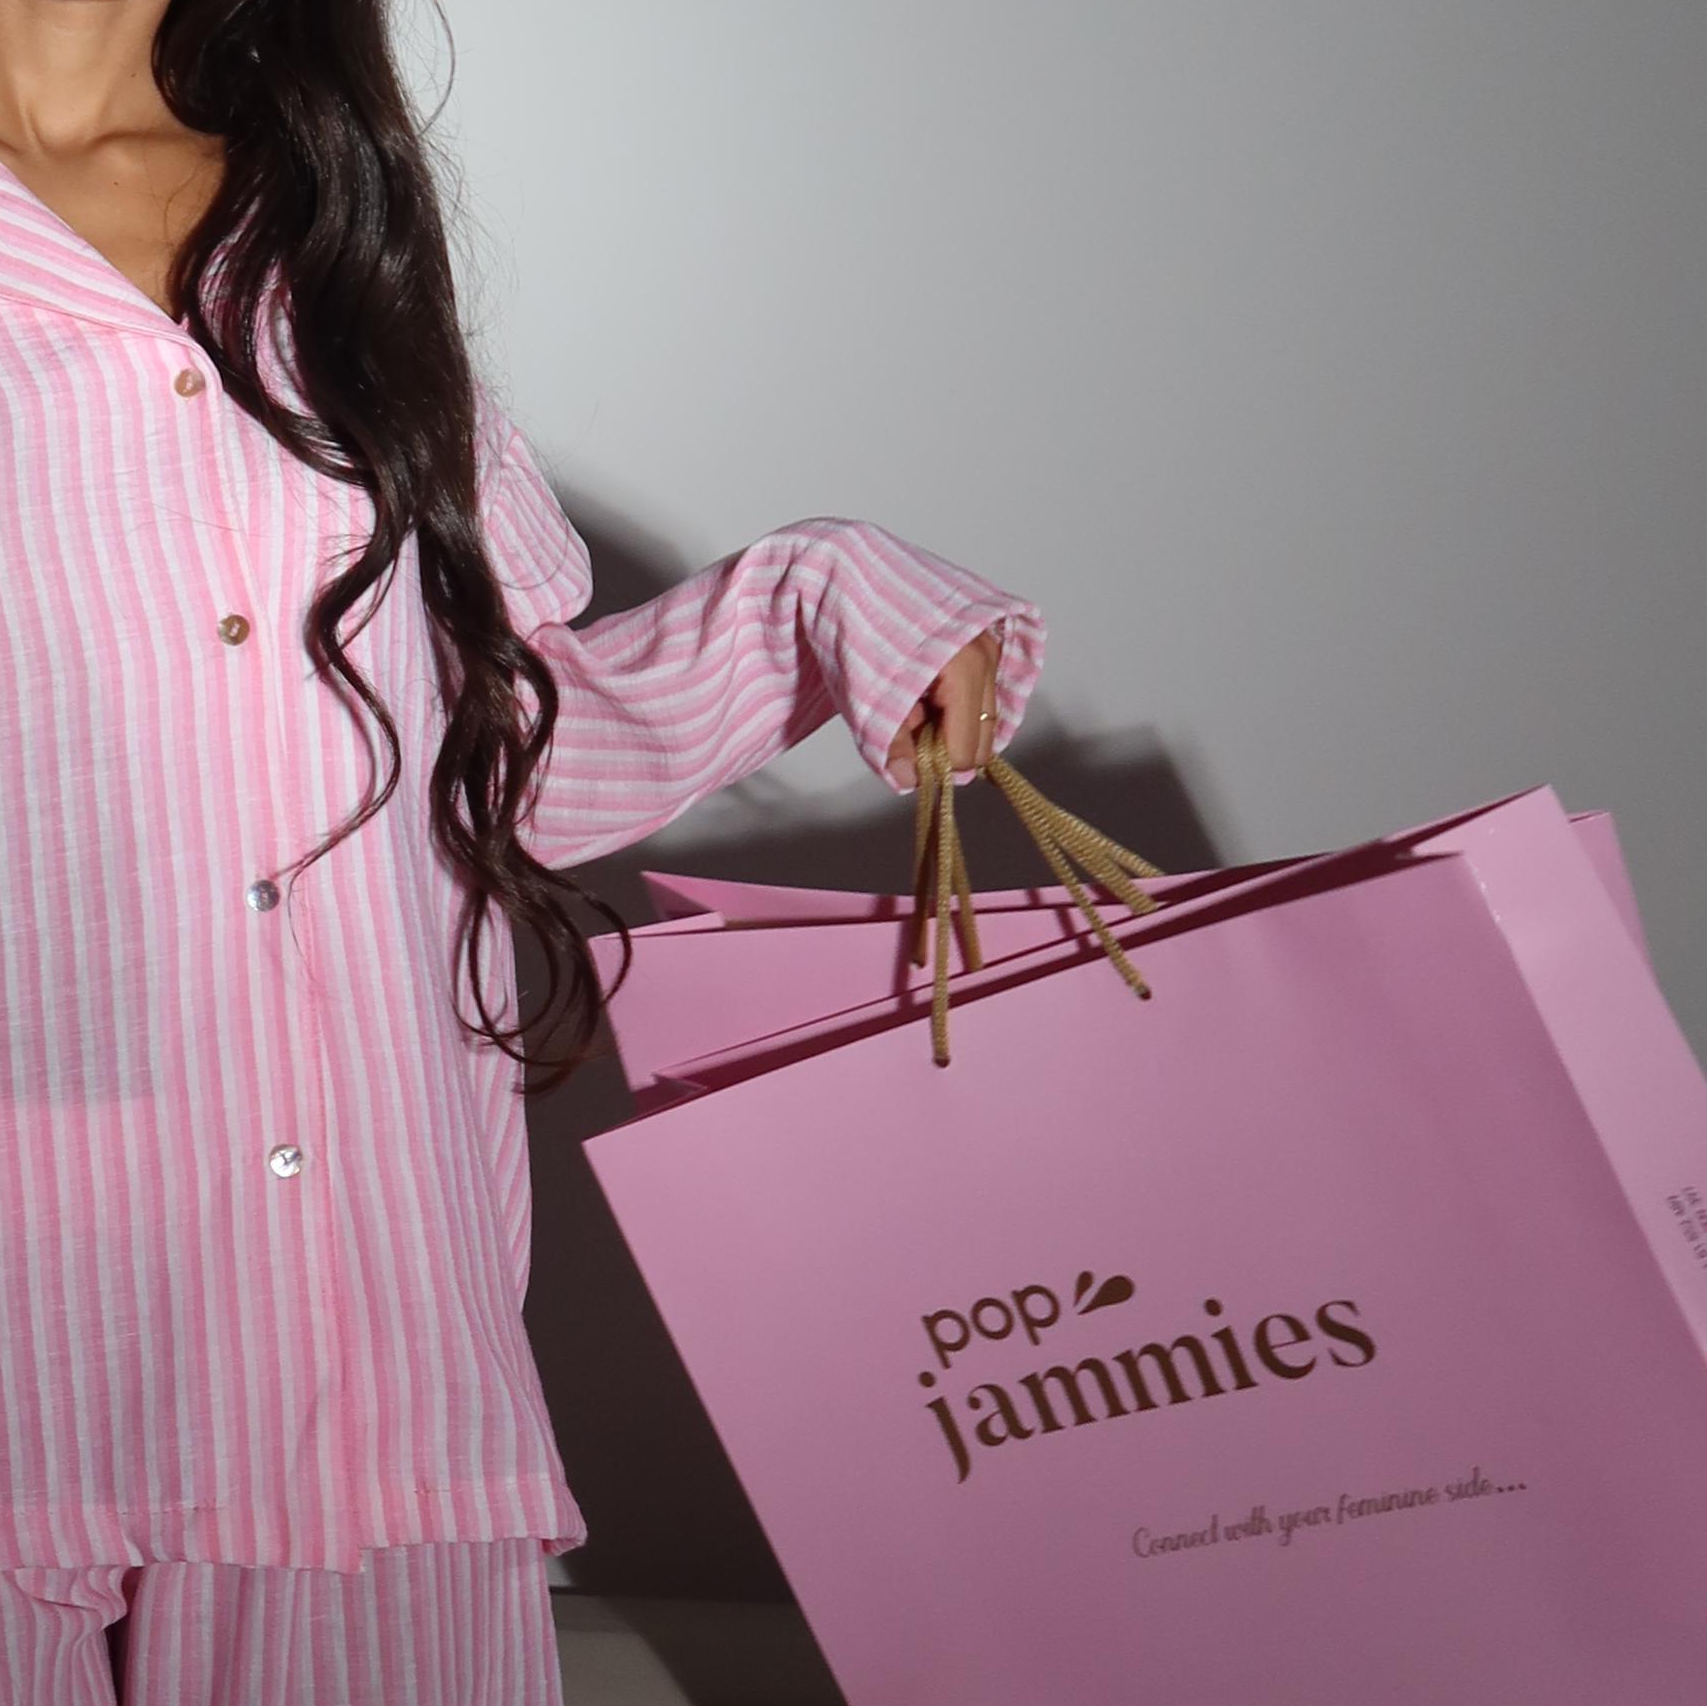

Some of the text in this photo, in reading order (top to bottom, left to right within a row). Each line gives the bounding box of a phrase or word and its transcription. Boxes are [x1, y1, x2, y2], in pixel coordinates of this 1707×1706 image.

[922, 1283, 1061, 1369] pop
[918, 1298, 1377, 1484] jammies
[1132, 1515, 1221, 1558] Connect
[1224, 1505, 1273, 1542] with
[1277, 1505, 1331, 1546] your
[1335, 1484, 1439, 1524] feminine
